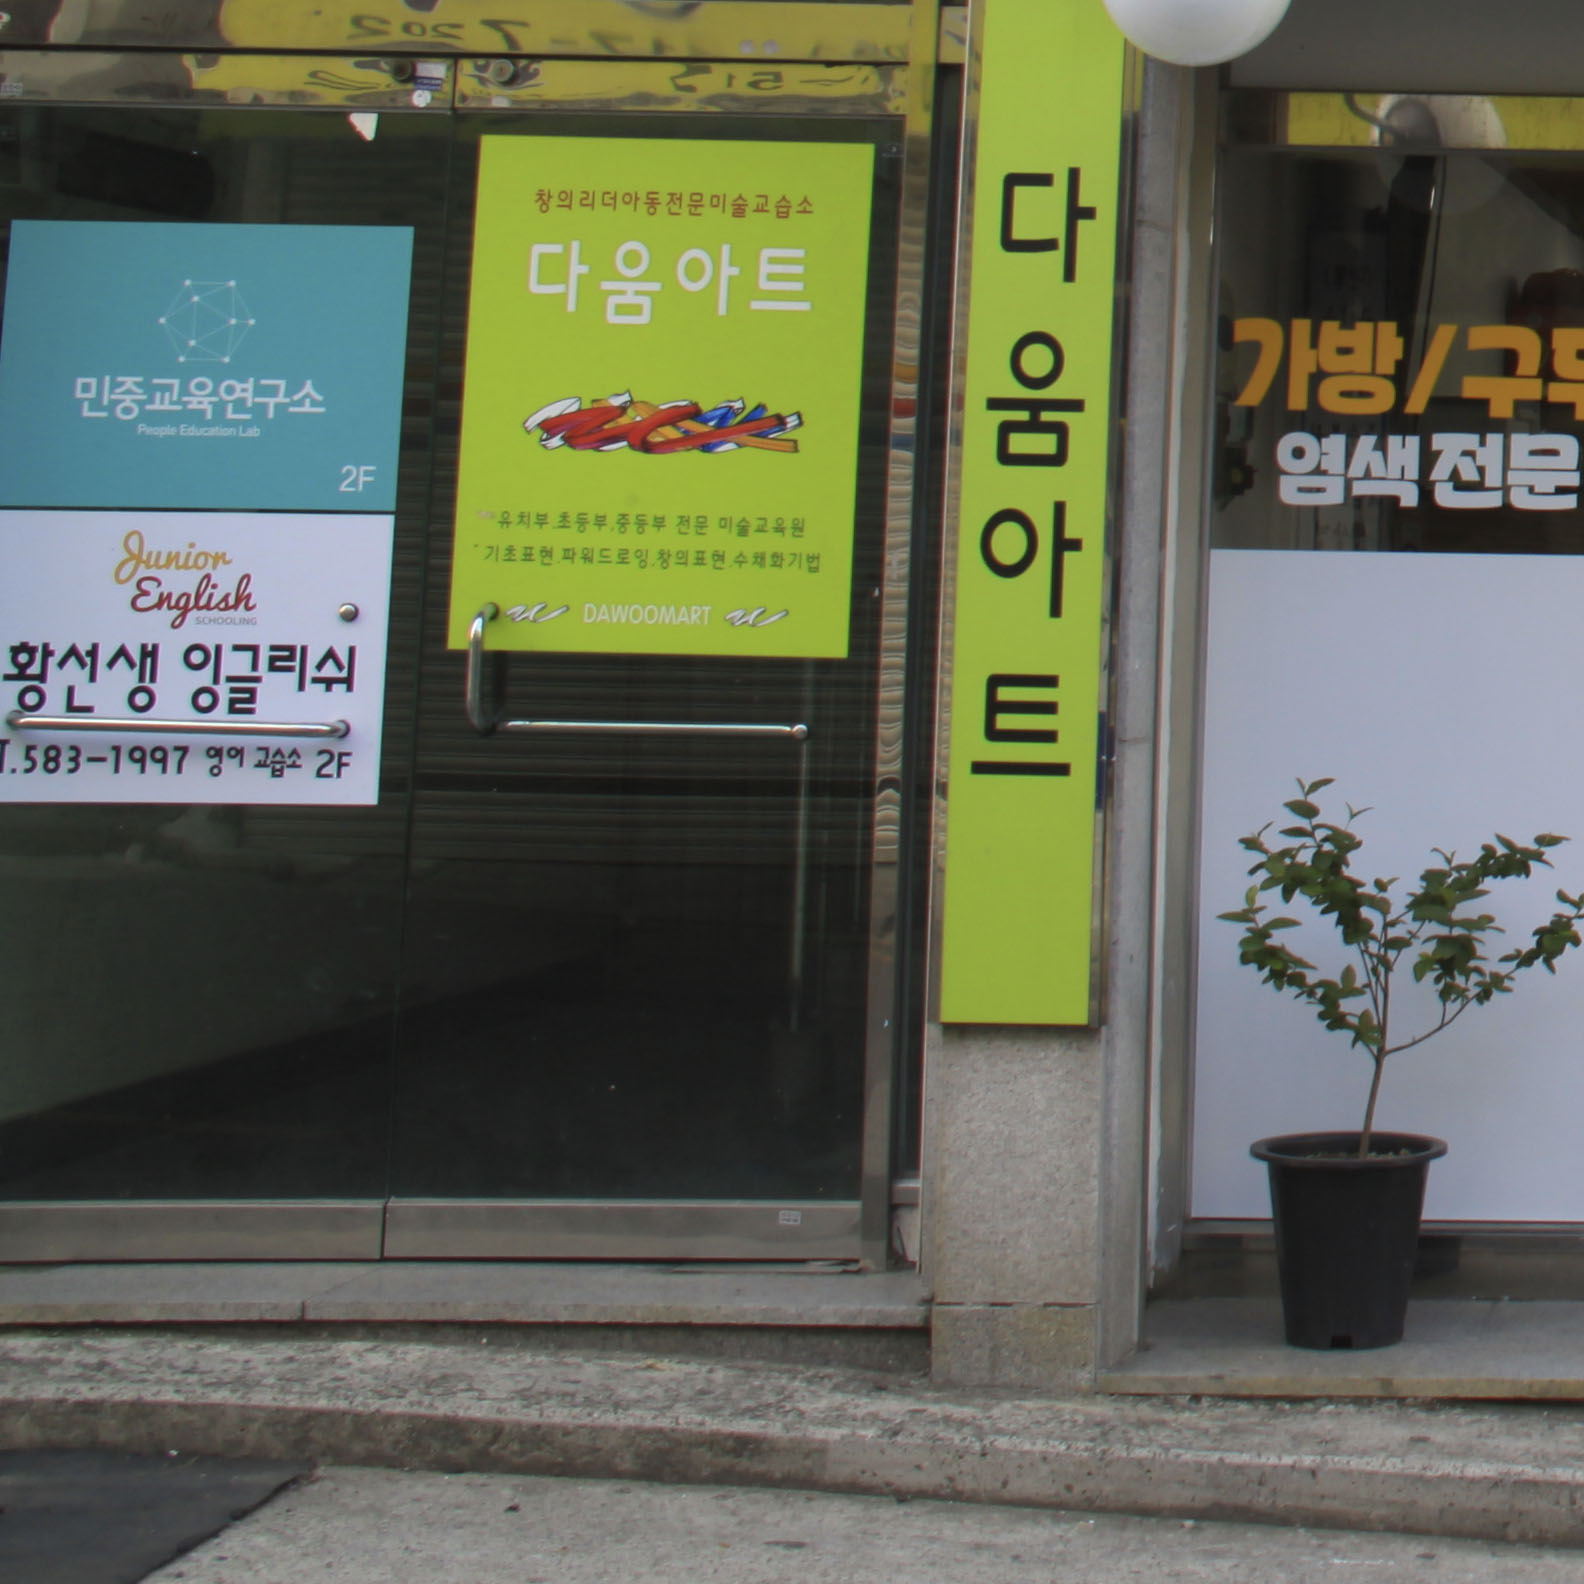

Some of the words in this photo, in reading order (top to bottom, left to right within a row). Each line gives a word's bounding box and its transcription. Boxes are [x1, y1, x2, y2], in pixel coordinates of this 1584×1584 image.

[534, 188, 814, 219] 창의리더아동전문미술교습소
[529, 239, 812, 325] 다움아트
[74, 374, 327, 421] 민중교육연구소
[137, 423, 177, 438] People
[179, 424, 237, 437] Education
[239, 425, 261, 438] Lab
[338, 465, 377, 493] 2F
[970, 165, 1097, 778] 다움아트
[675, 514, 709, 536] 전문
[719, 516, 806, 538] 미술교육원
[114, 529, 232, 585] Junior
[130, 573, 257, 629] English
[583, 602, 711, 625] DAWOOMART
[195, 616, 257, 626] SCHOOLING
[2, 641, 160, 714] 황선생
[183, 643, 357, 715] 잉글리쉬
[206, 745, 245, 778] 영어
[253, 746, 303, 778] 교습소
[316, 749, 354, 779] 2F
